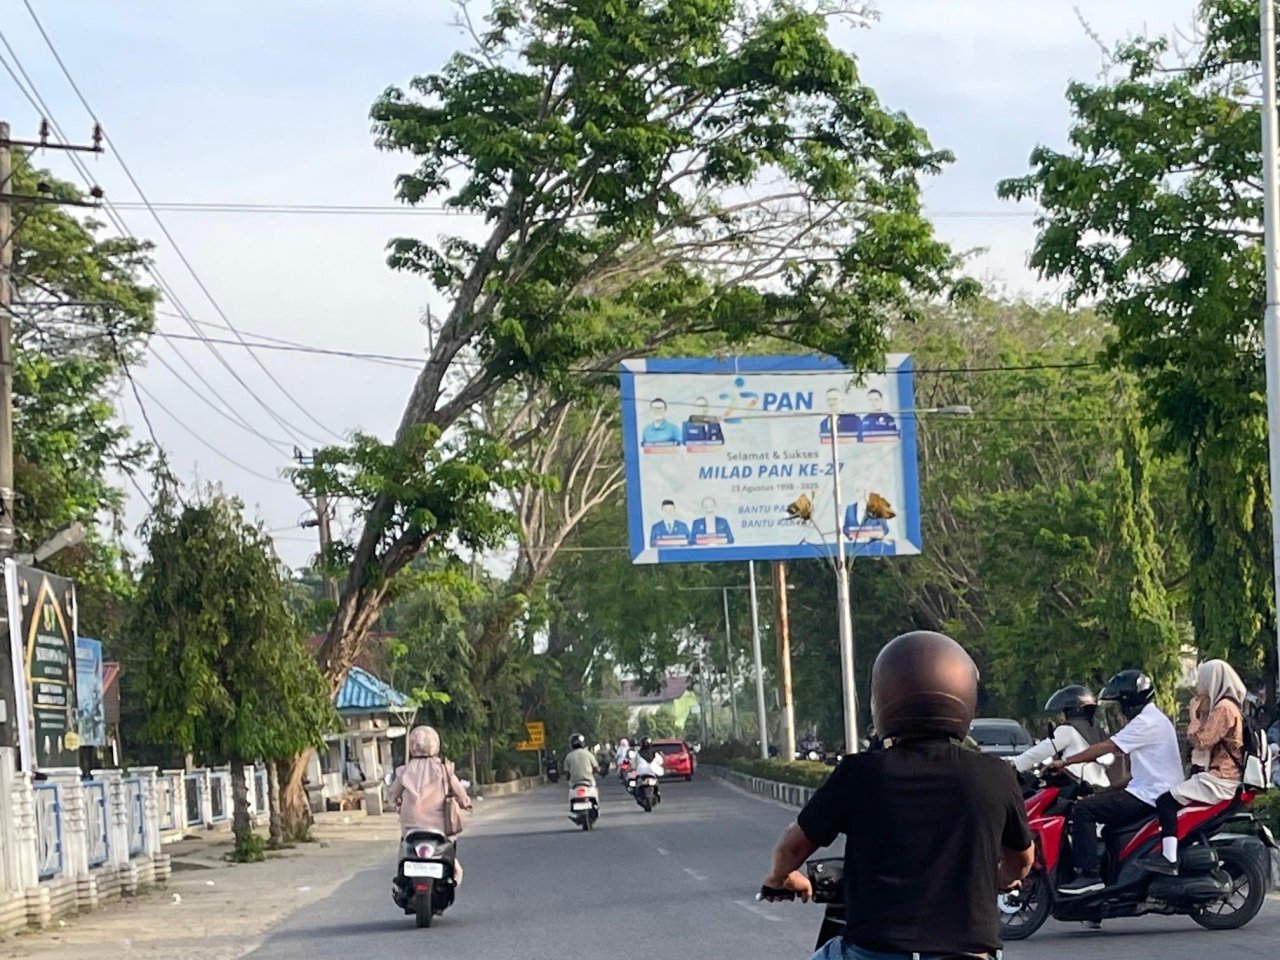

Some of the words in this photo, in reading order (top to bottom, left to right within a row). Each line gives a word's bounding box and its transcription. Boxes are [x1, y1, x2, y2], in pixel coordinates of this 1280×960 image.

[763, 391, 813, 411] PAN
[727, 451, 769, 461] Selamat
[773, 450, 780, 459] &
[783, 450, 819, 459] Sukses
[699, 465, 753, 480] MILAD
[758, 464, 793, 478] PAN
[738, 505, 771, 514] BANTU
[741, 519, 774, 528] BANTU
